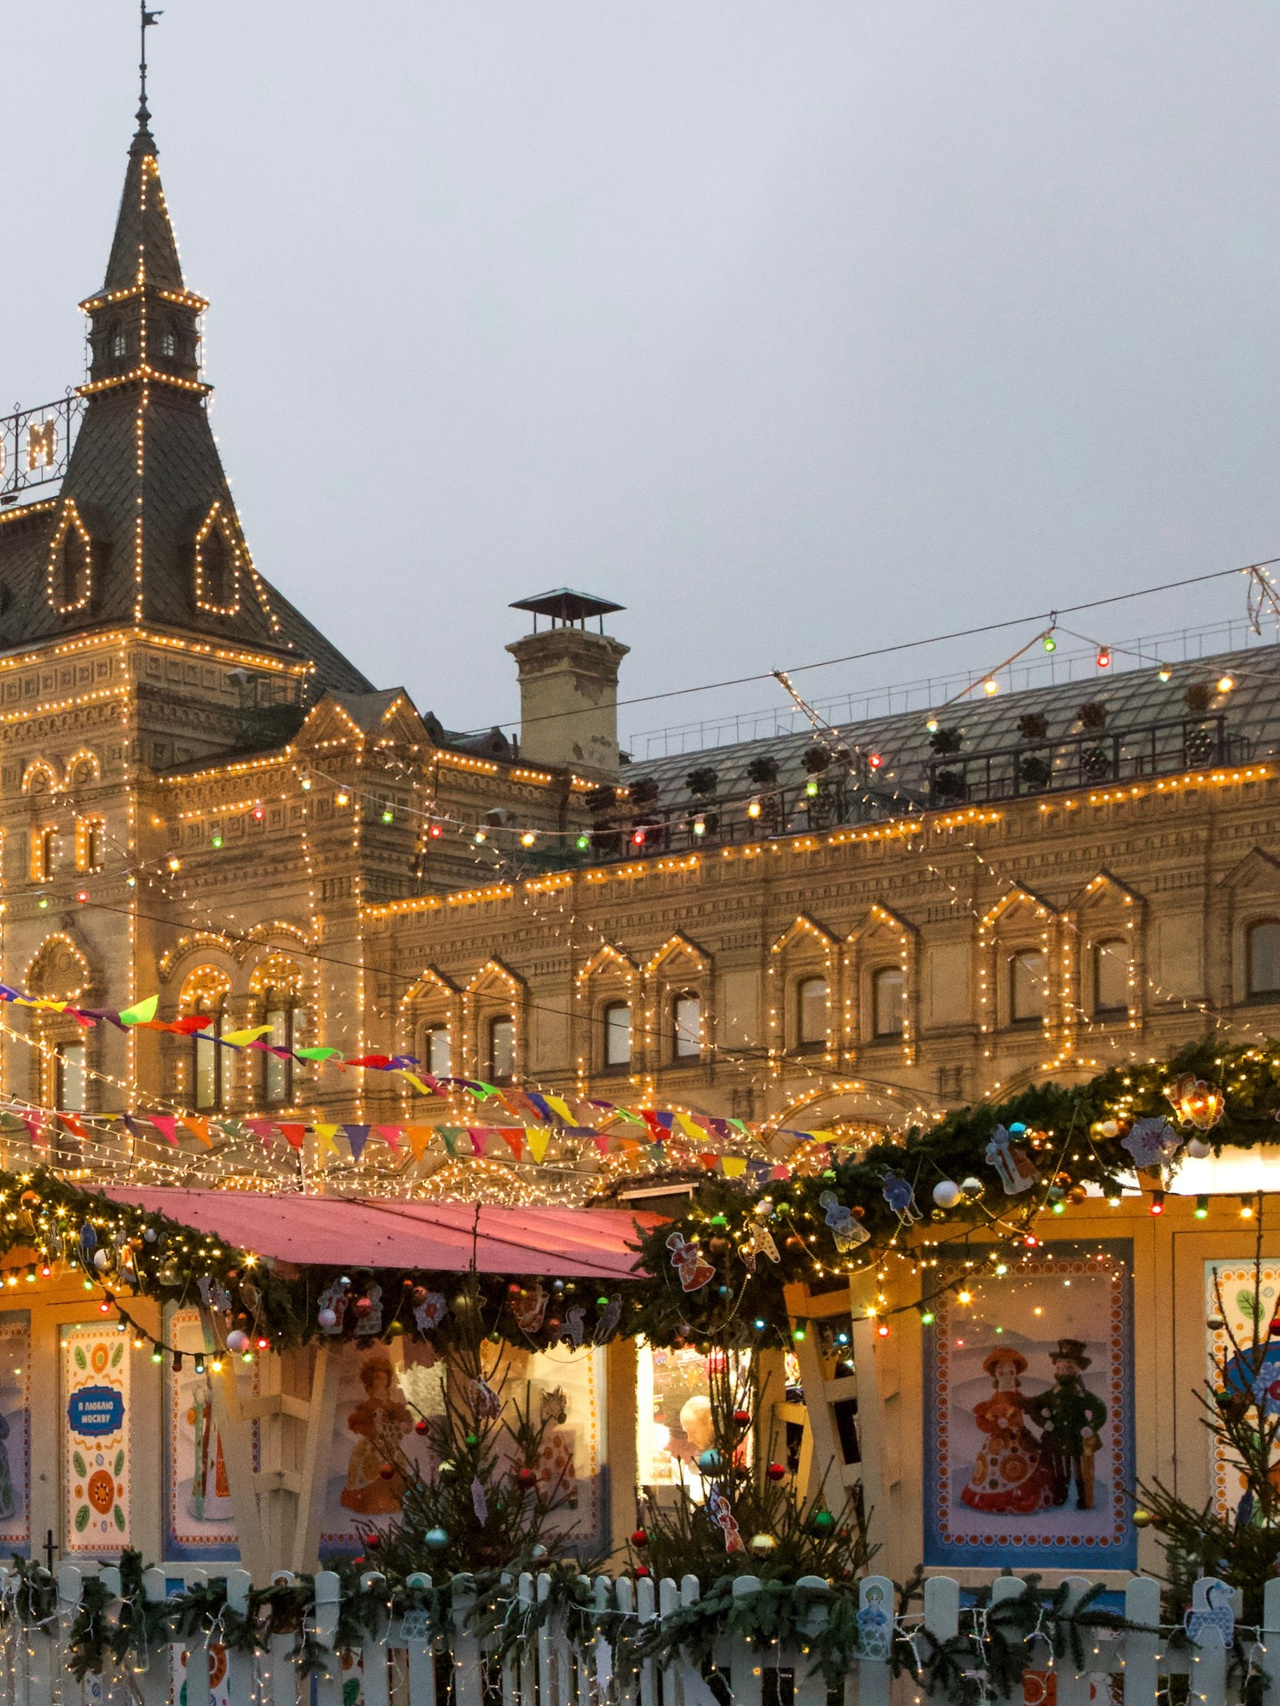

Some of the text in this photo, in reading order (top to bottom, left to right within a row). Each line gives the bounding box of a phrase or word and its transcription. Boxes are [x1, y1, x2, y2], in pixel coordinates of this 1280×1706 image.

[78, 1402, 113, 1411] Я ЛЮБЛЮ
[82, 1415, 110, 1423] МОСКВУ
